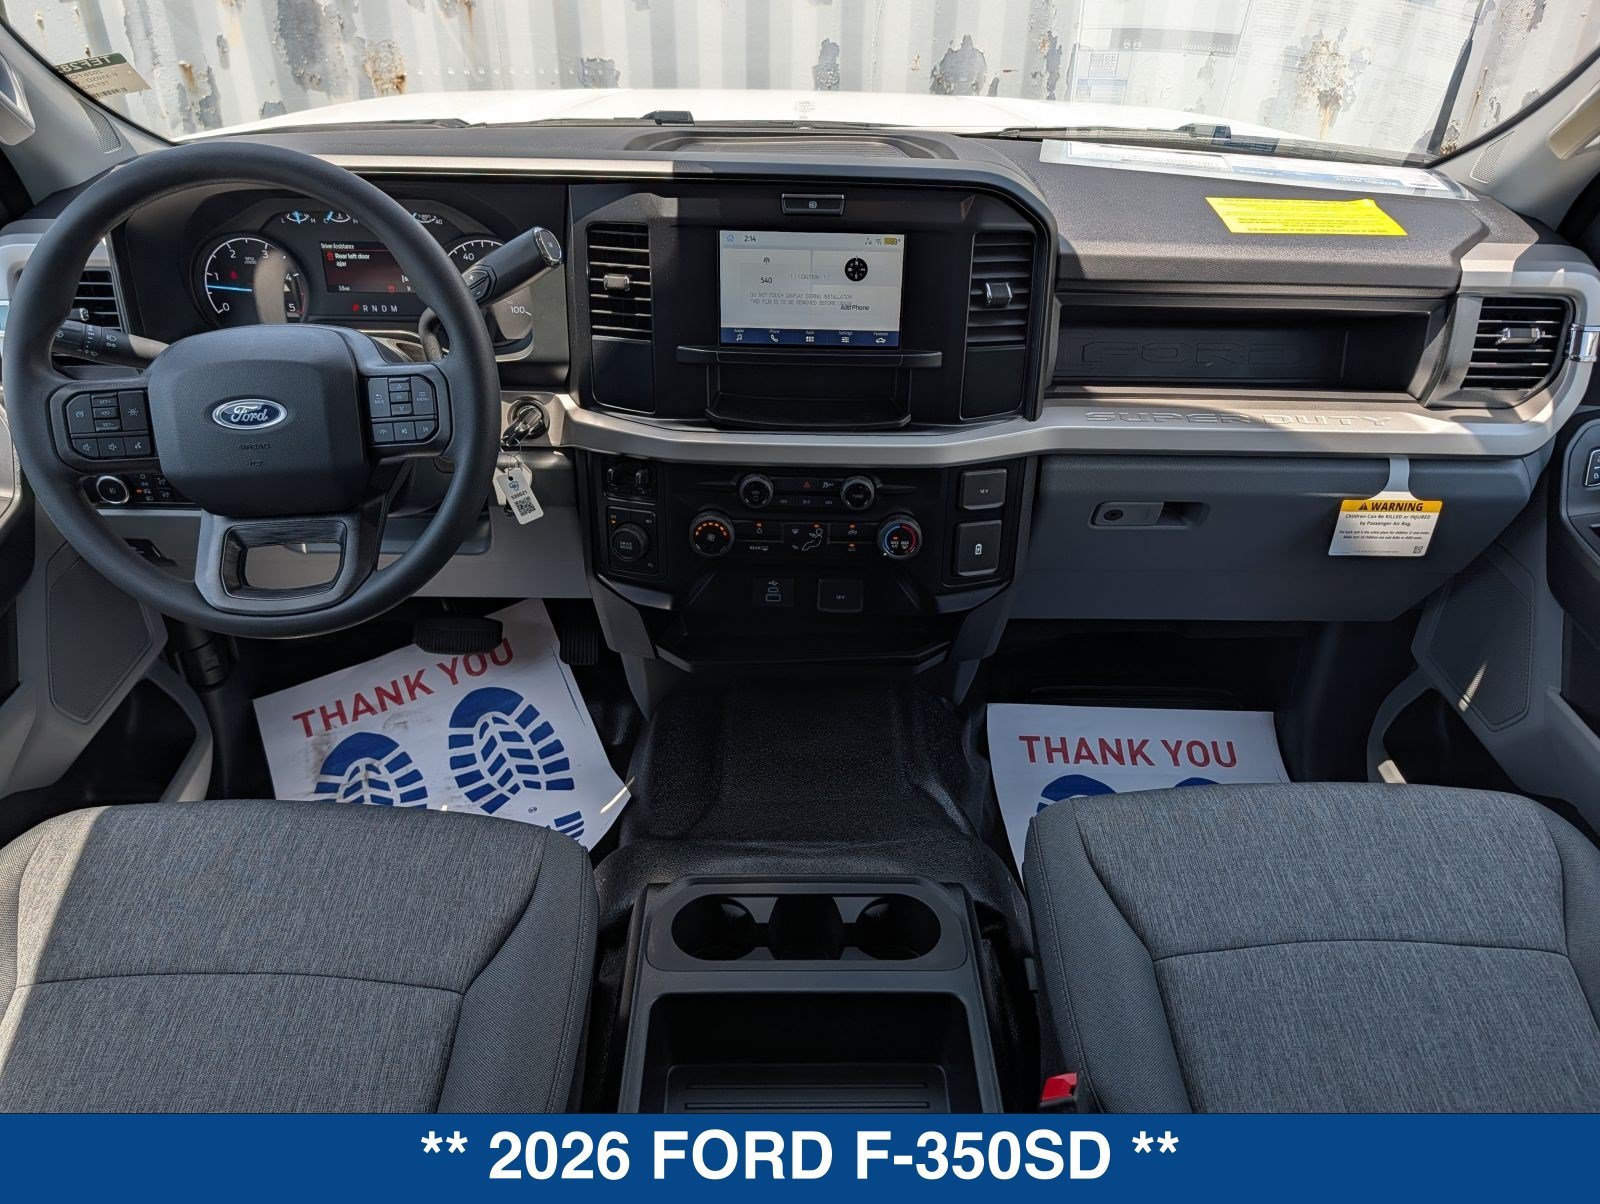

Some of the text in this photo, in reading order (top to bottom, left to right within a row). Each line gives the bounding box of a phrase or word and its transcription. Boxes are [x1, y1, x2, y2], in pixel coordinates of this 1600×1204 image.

[229, 250, 236, 258] 2
[261, 250, 268, 258] 3
[463, 253, 475, 261] 40
[222, 303, 230, 311] 0
[511, 306, 526, 314] 100
[231, 405, 268, 422] Ford
[1085, 411, 1393, 427] SUPER DUTY
[1371, 502, 1424, 511] WARNING
[292, 637, 514, 738] THANK YOU
[1019, 735, 1238, 768] THANK YOU
